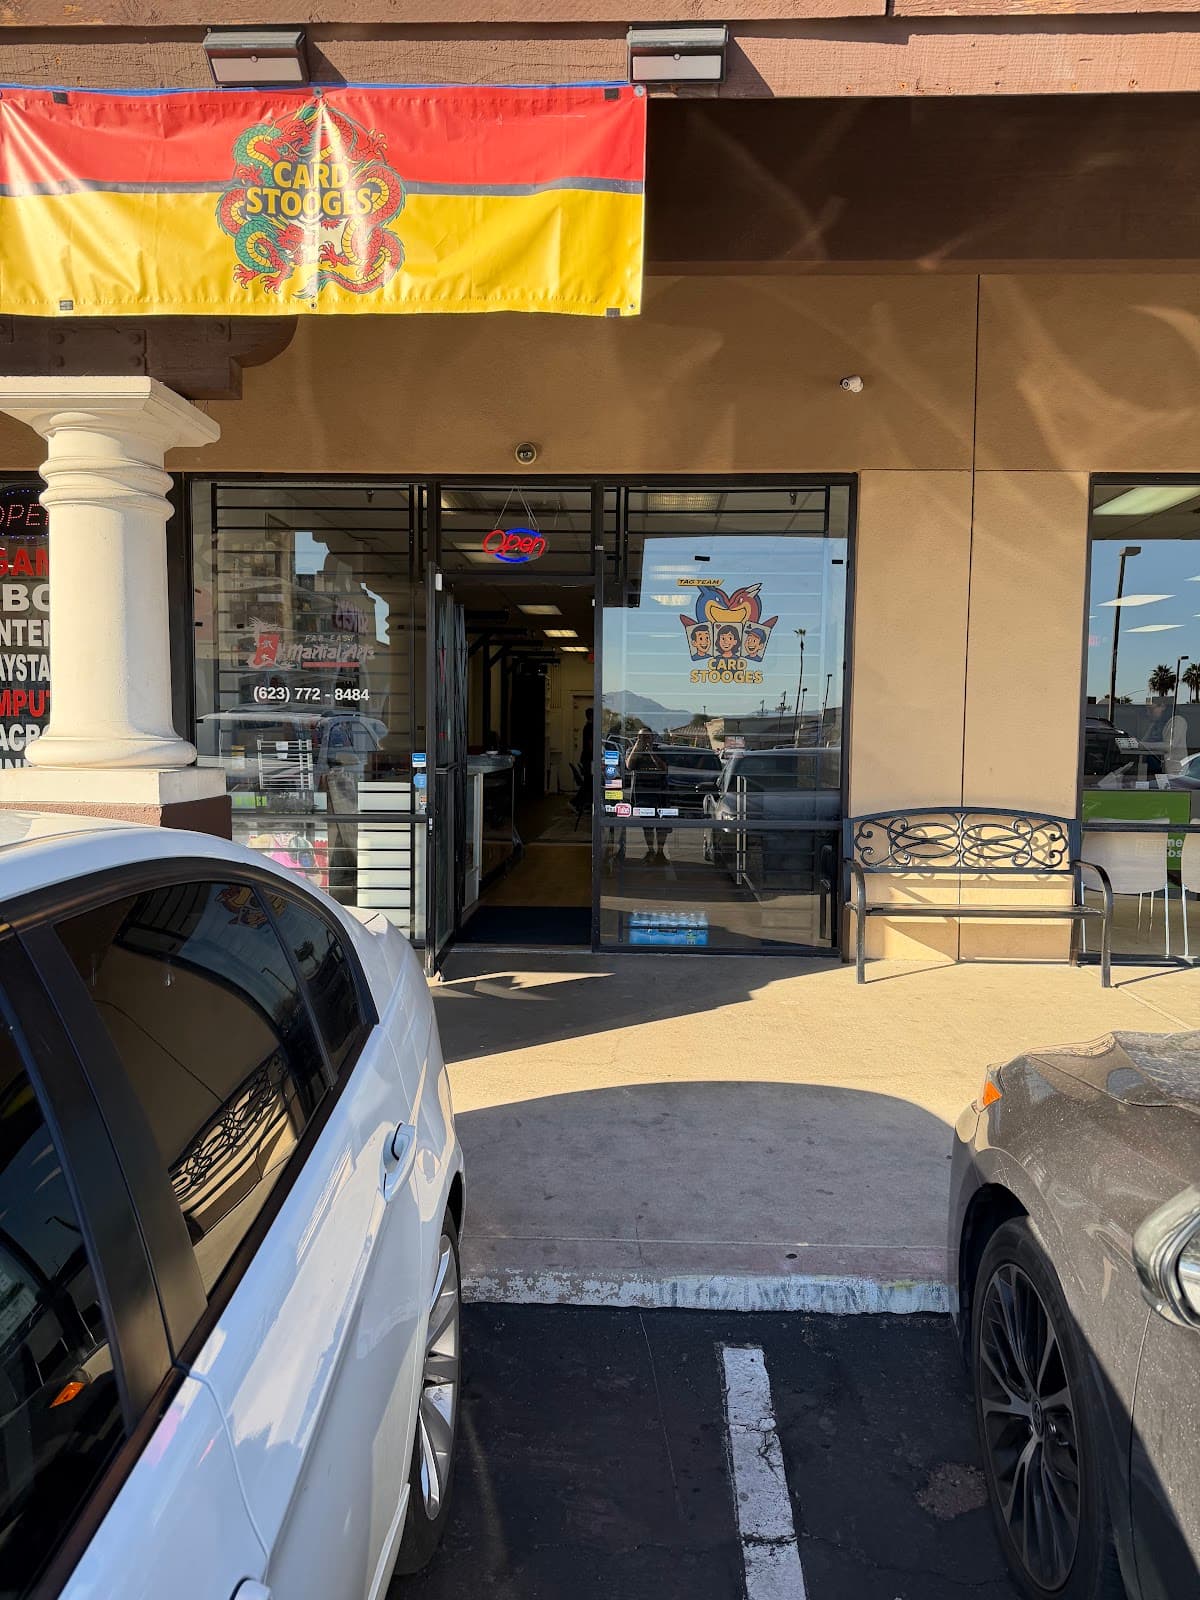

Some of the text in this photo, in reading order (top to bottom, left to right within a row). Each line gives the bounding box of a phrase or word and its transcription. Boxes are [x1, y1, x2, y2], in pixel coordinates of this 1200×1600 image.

[273, 161, 350, 189] CARD
[246, 186, 373, 217] STOOGES
[482, 529, 546, 557] Open
[708, 658, 748, 671] CARD
[690, 669, 764, 684] STOOGES
[253, 686, 290, 702] (623)
[295, 687, 321, 701] 772
[334, 688, 370, 701] 8484
